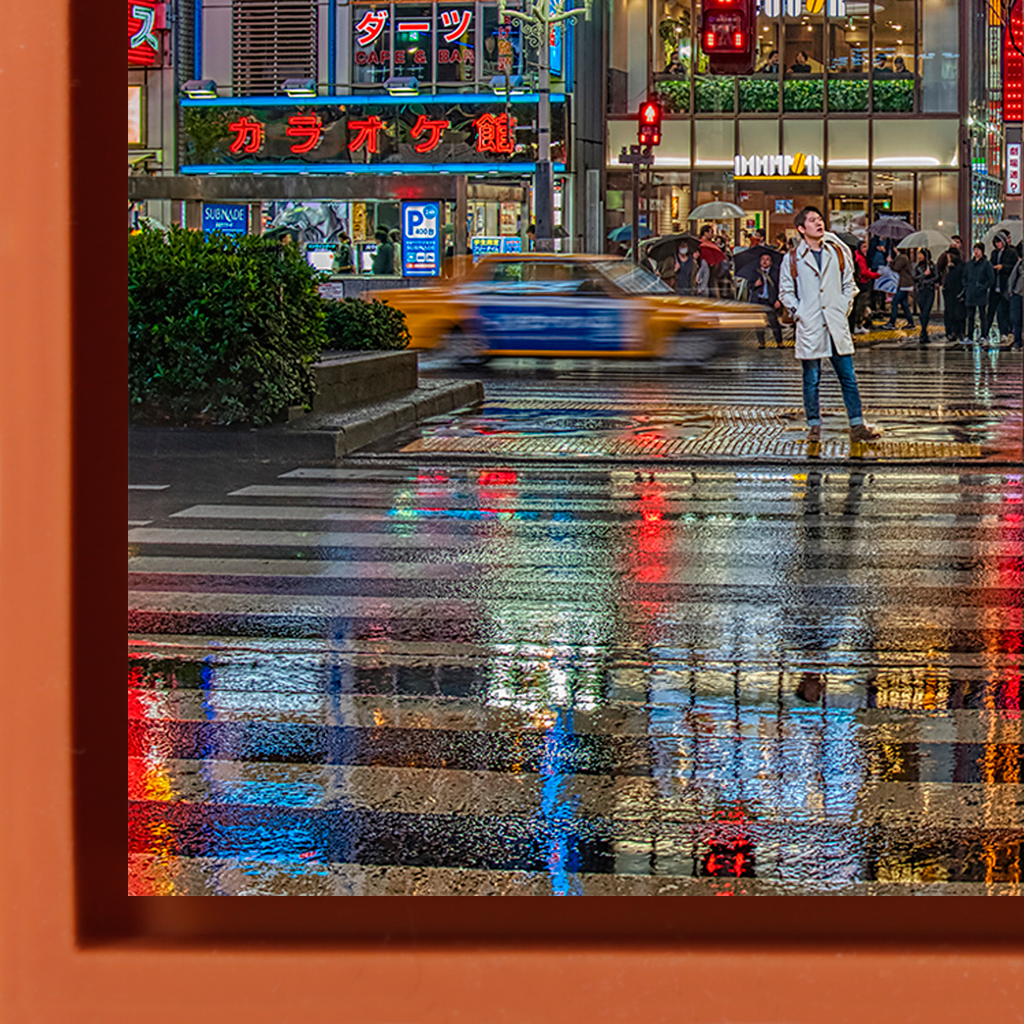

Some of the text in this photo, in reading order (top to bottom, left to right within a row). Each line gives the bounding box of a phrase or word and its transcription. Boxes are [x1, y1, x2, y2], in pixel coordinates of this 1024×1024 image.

[355, 9, 473, 47] ダーツ
[354, 49, 407, 65] CAFE
[437, 48, 475, 64] BAR
[228, 110, 515, 155] カラオケ館
[733, 152, 822, 177] DOUTOR
